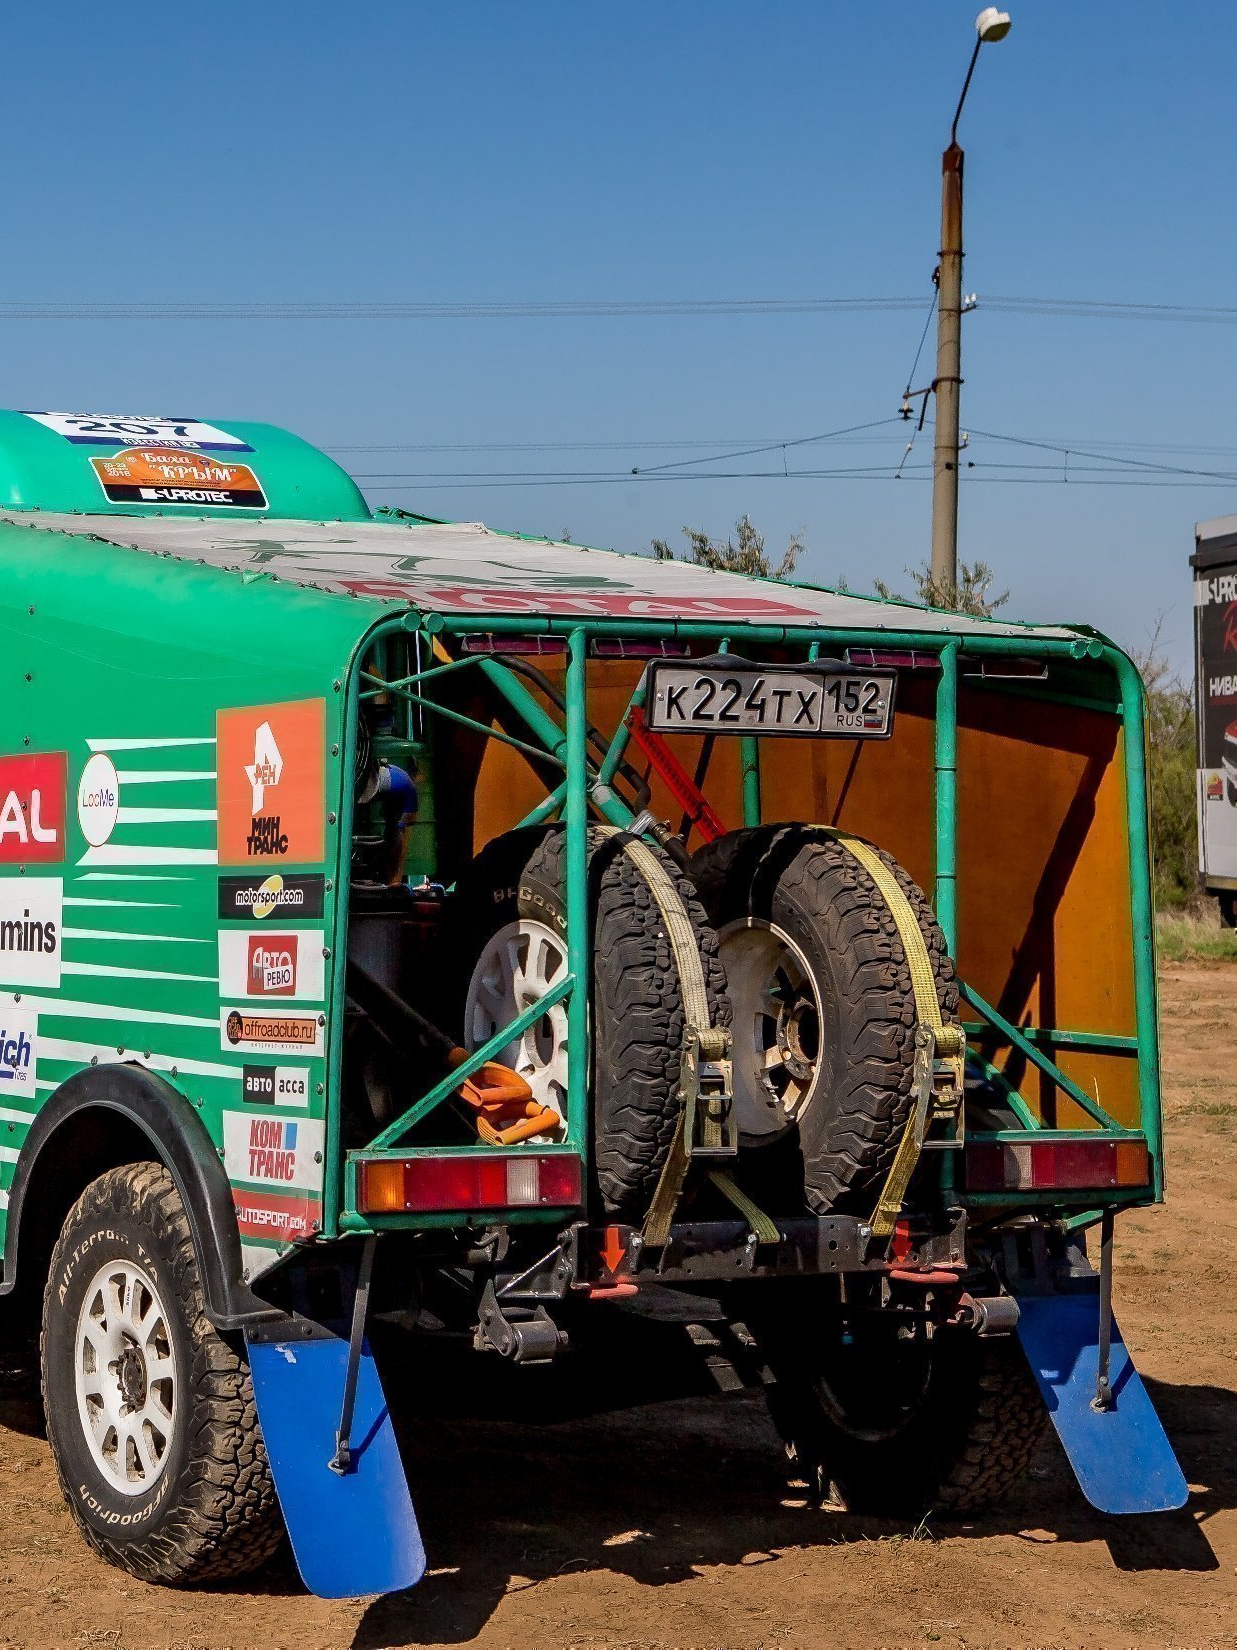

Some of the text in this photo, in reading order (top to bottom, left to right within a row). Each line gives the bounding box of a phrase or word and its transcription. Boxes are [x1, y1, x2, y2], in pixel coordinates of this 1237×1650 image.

[65, 419, 190, 437] 207
[140, 452, 193, 464] Баха
[153, 488, 233, 503] SUPROTEC
[367, 585, 788, 614] TOTAL
[826, 680, 881, 714] 152
[836, 714, 863, 727] RUS
[254, 764, 276, 785] РЕН
[81, 788, 115, 808] LocMe
[251, 816, 281, 838] МИН
[246, 834, 289, 856] ТРАНС
[235, 887, 304, 907] motorsport.com
[266, 968, 291, 987] РЕВЮ
[244, 1020, 312, 1039] offroadclub.ru
[246, 1076, 305, 1094] авто асса
[249, 1119, 283, 1150] КОМ
[248, 1148, 296, 1181] ТРАНС
[58, 1229, 129, 1307] All-Terrain
[79, 1472, 169, 1526] BFGoodrich
